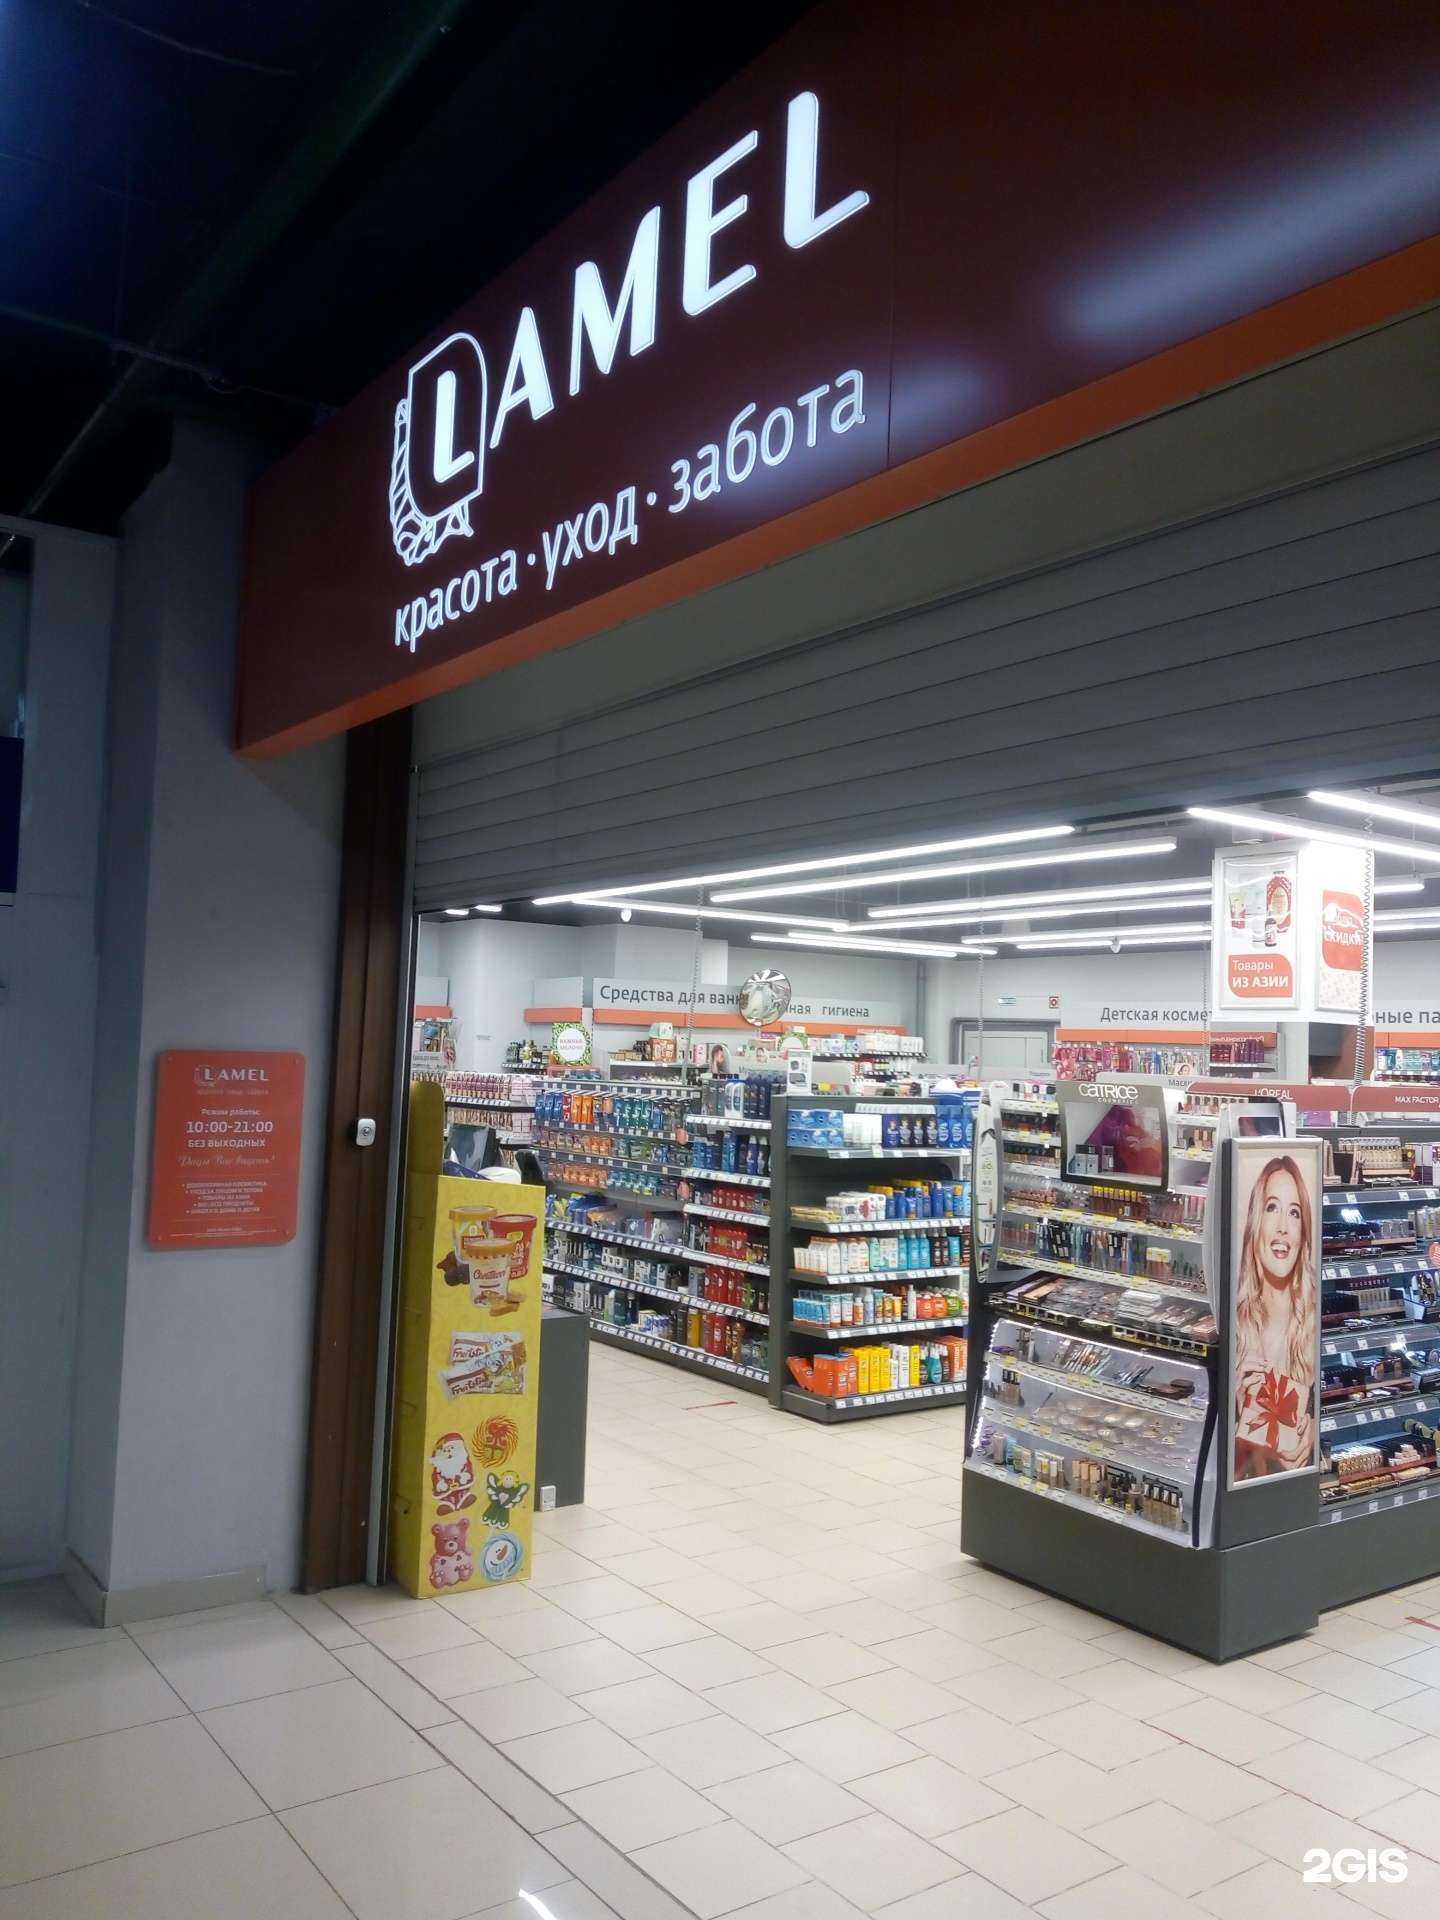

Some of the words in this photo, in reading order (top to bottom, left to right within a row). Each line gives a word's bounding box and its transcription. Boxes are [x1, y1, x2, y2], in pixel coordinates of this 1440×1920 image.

[433, 91, 870, 483] LAMEL
[394, 549, 517, 652] красота
[541, 486, 638, 590] уход
[668, 369, 865, 514] забота
[1232, 959, 1273, 973] Товары
[1232, 977, 1249, 988] ИЗ
[1251, 975, 1289, 988] АЗИИ
[600, 985, 674, 1003] Средства
[677, 993, 706, 1005] для
[785, 1003, 811, 1015] ная
[821, 1005, 870, 1018] гигиена
[1100, 1007, 1158, 1022] Детская
[1373, 1010, 1413, 1024] ные
[204, 1068, 269, 1081] LAMEL
[1412, 1096, 1439, 1104] FACTOR
[186, 1121, 273, 1133] 10:00-21:00
[188, 1139, 206, 1148] БЕЗ
[208, 1138, 266, 1148] ВЫХОДНЫХ
